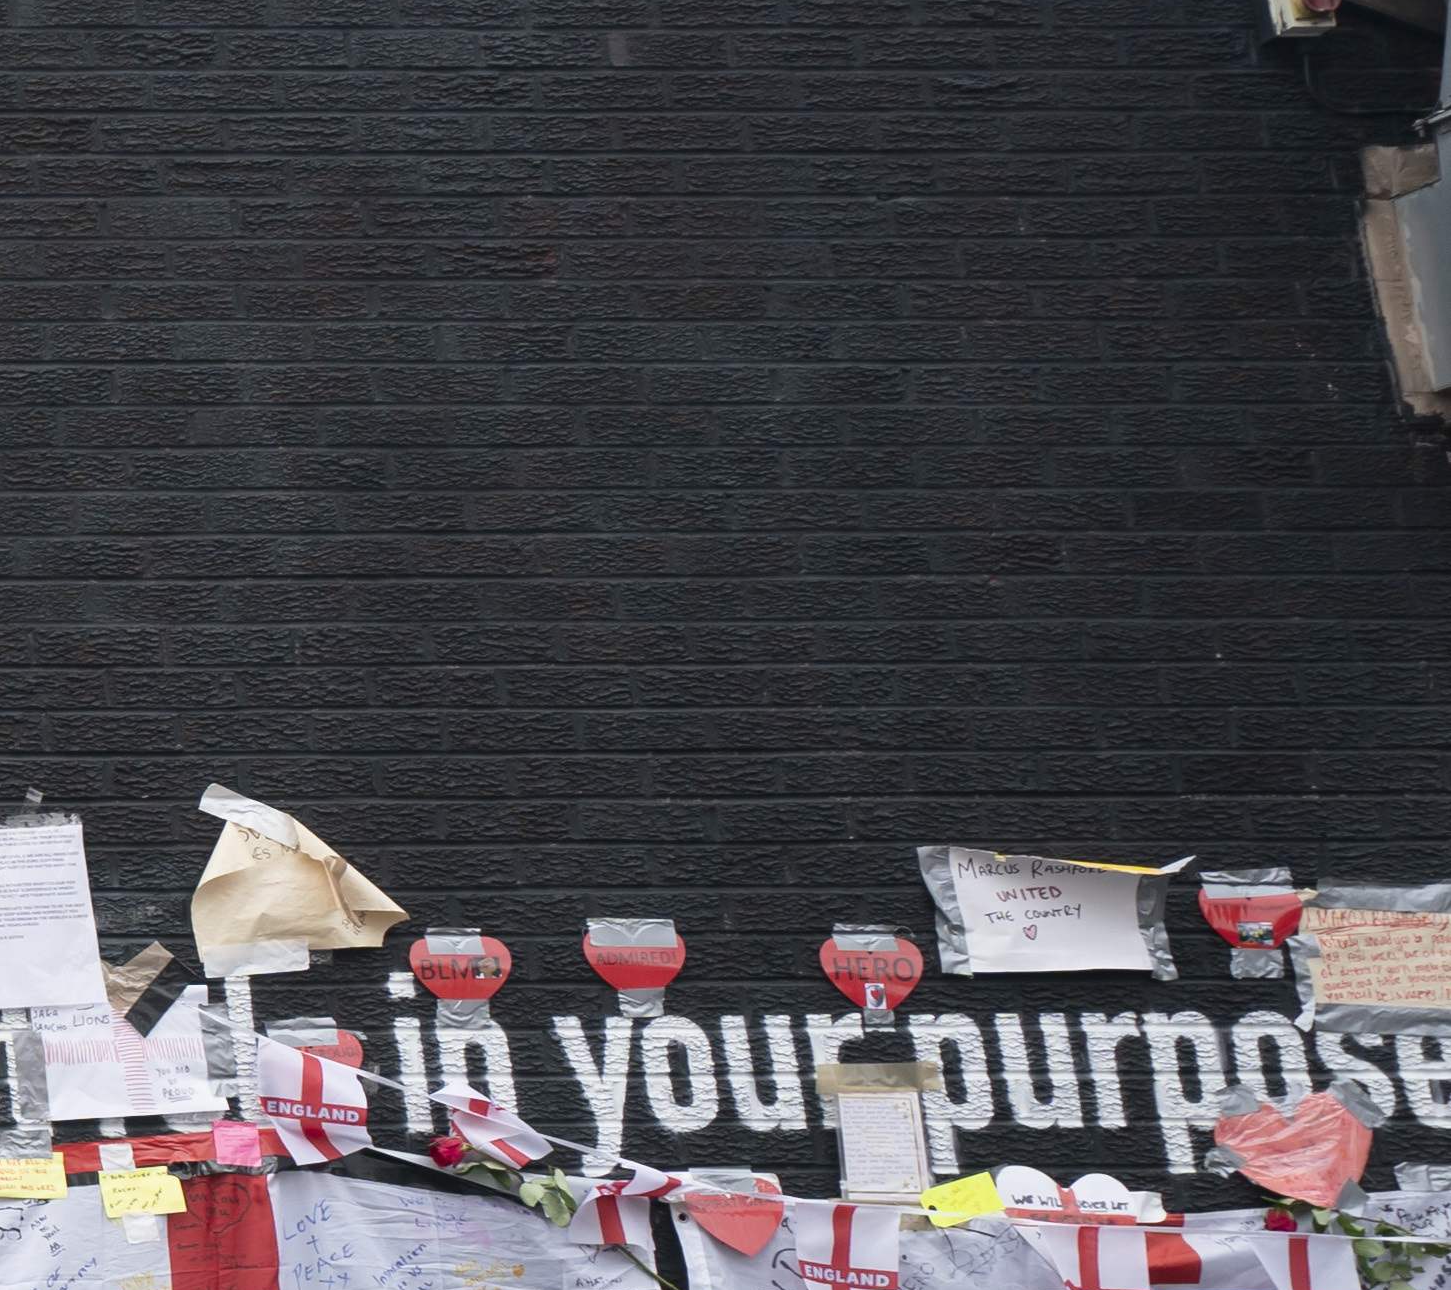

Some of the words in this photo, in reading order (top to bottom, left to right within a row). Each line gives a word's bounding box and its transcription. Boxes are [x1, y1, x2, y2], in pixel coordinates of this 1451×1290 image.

[958, 858, 1020, 878] MARCUS
[996, 885, 1061, 901] UNITED
[985, 910, 1014, 923] THE
[1024, 903, 1082, 921] COUNTRY
[595, 952, 677, 966] ADMIRED!
[834, 955, 915, 982] HERO
[73, 1012, 112, 1027] LIONS
[387, 972, 519, 1133] in
[552, 1013, 864, 1178] your
[908, 1011, 1451, 1175] purpose
[266, 1100, 360, 1124] ENGLAND
[282, 1199, 332, 1241] LOVE
[804, 1263, 890, 1287] ENGLAND
